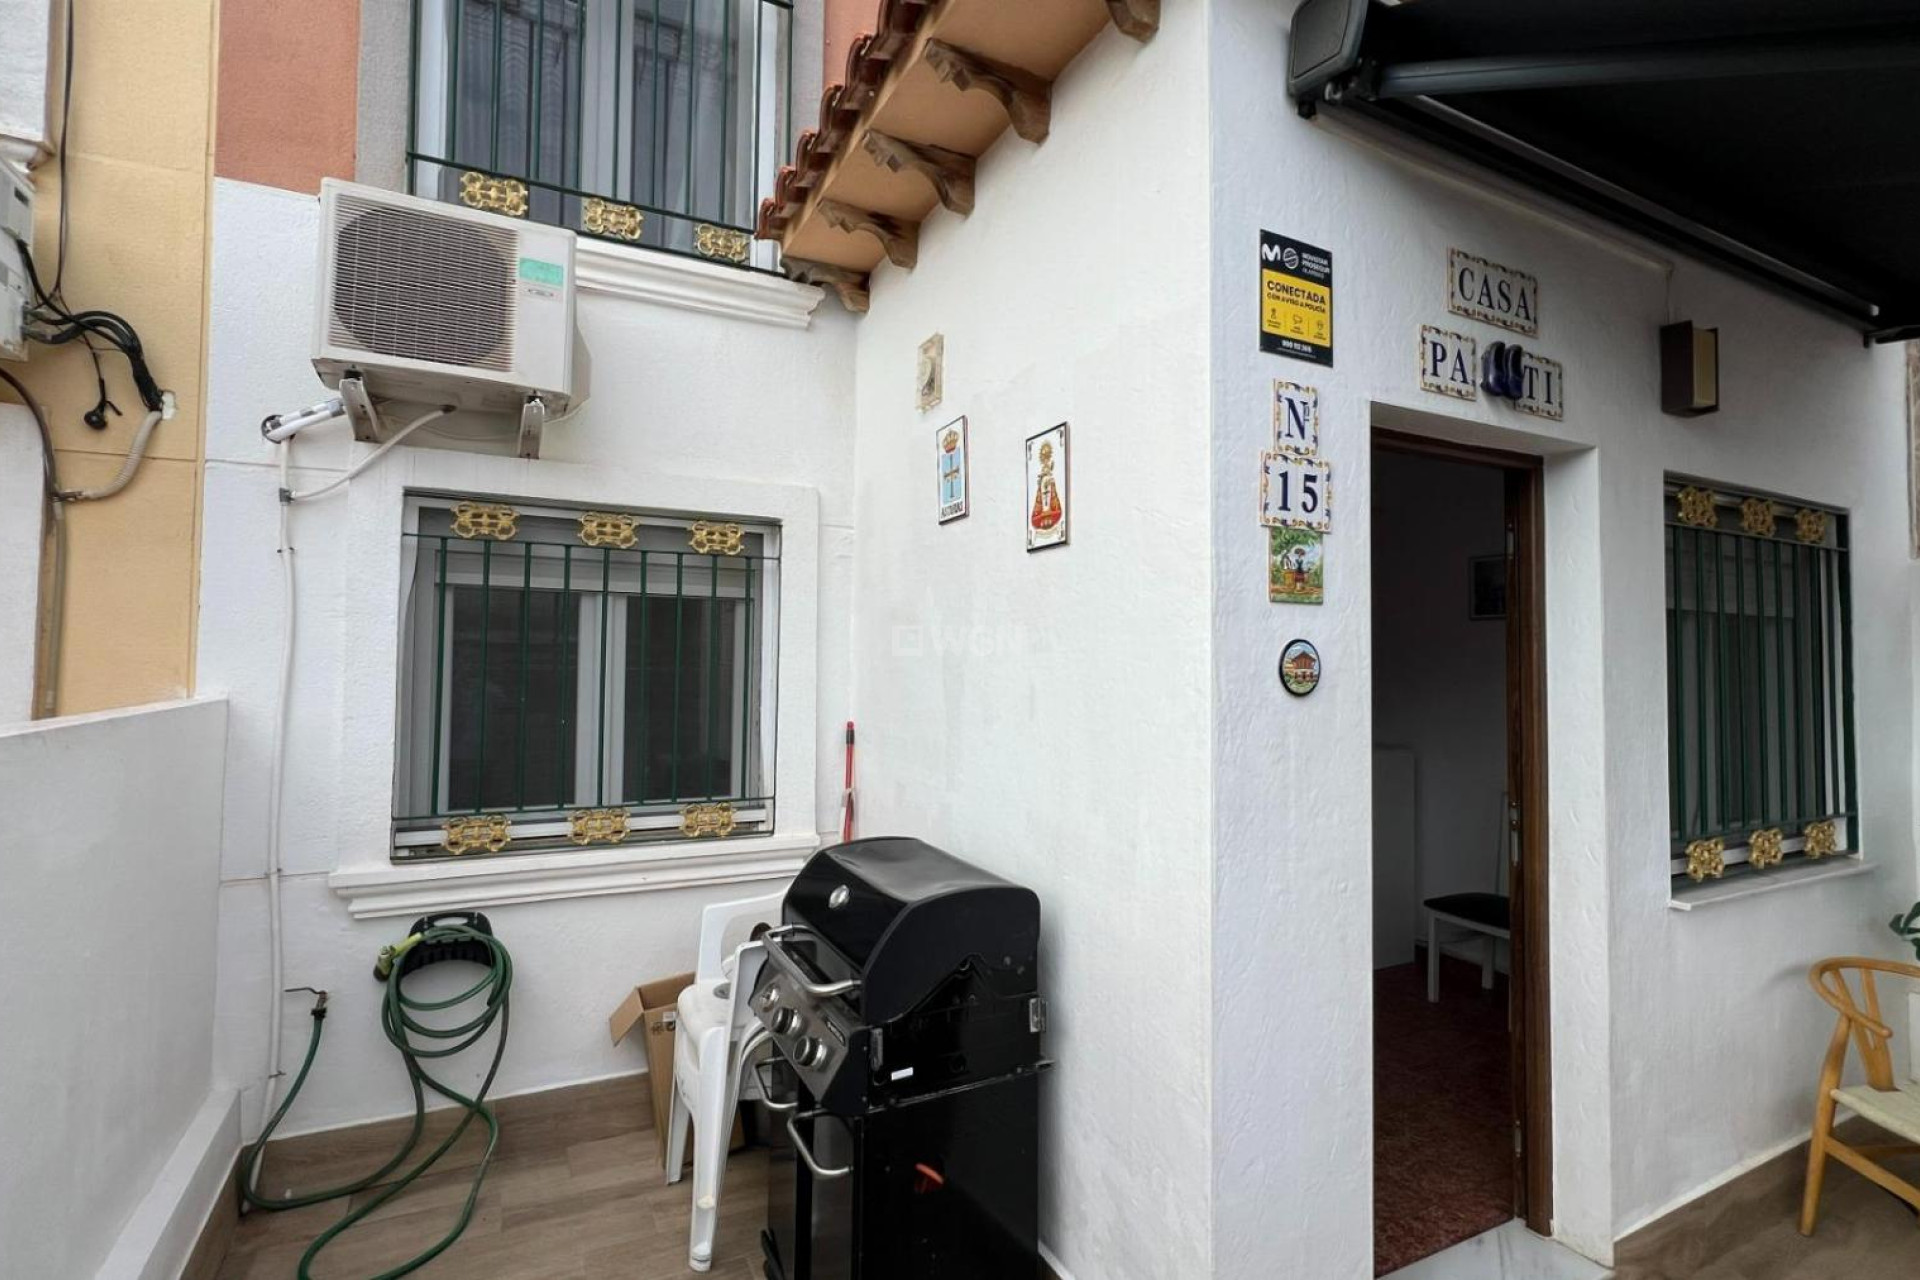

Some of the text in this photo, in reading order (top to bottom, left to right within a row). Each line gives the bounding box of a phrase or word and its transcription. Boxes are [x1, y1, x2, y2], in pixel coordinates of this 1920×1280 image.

[1267, 280, 1326, 305] CONECTADA
[1267, 292, 1281, 301] CON
[1458, 267, 1532, 321] CASA
[1278, 471, 1318, 514] 15
